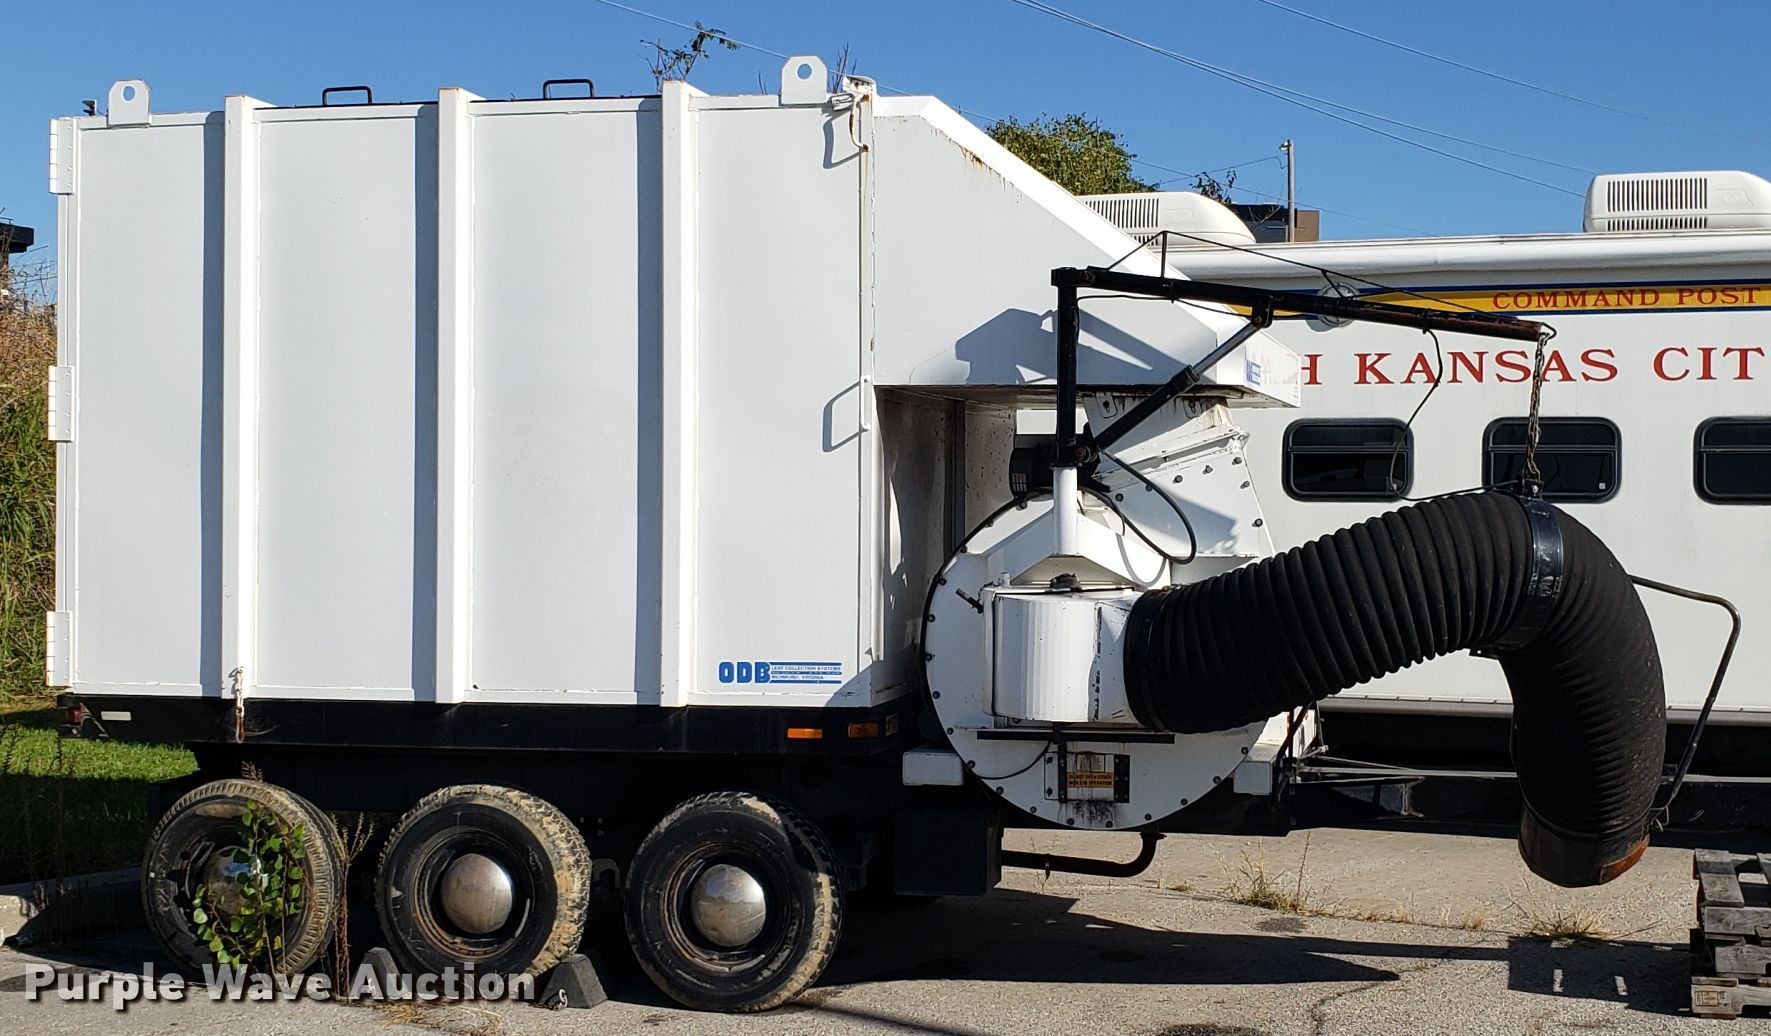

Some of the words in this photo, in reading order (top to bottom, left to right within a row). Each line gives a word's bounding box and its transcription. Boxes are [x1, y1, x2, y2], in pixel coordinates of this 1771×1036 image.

[1493, 289, 1660, 310] COMMAND
[1678, 287, 1761, 306] POST
[1354, 349, 1618, 385] KANSAS
[719, 661, 770, 683] ODB
